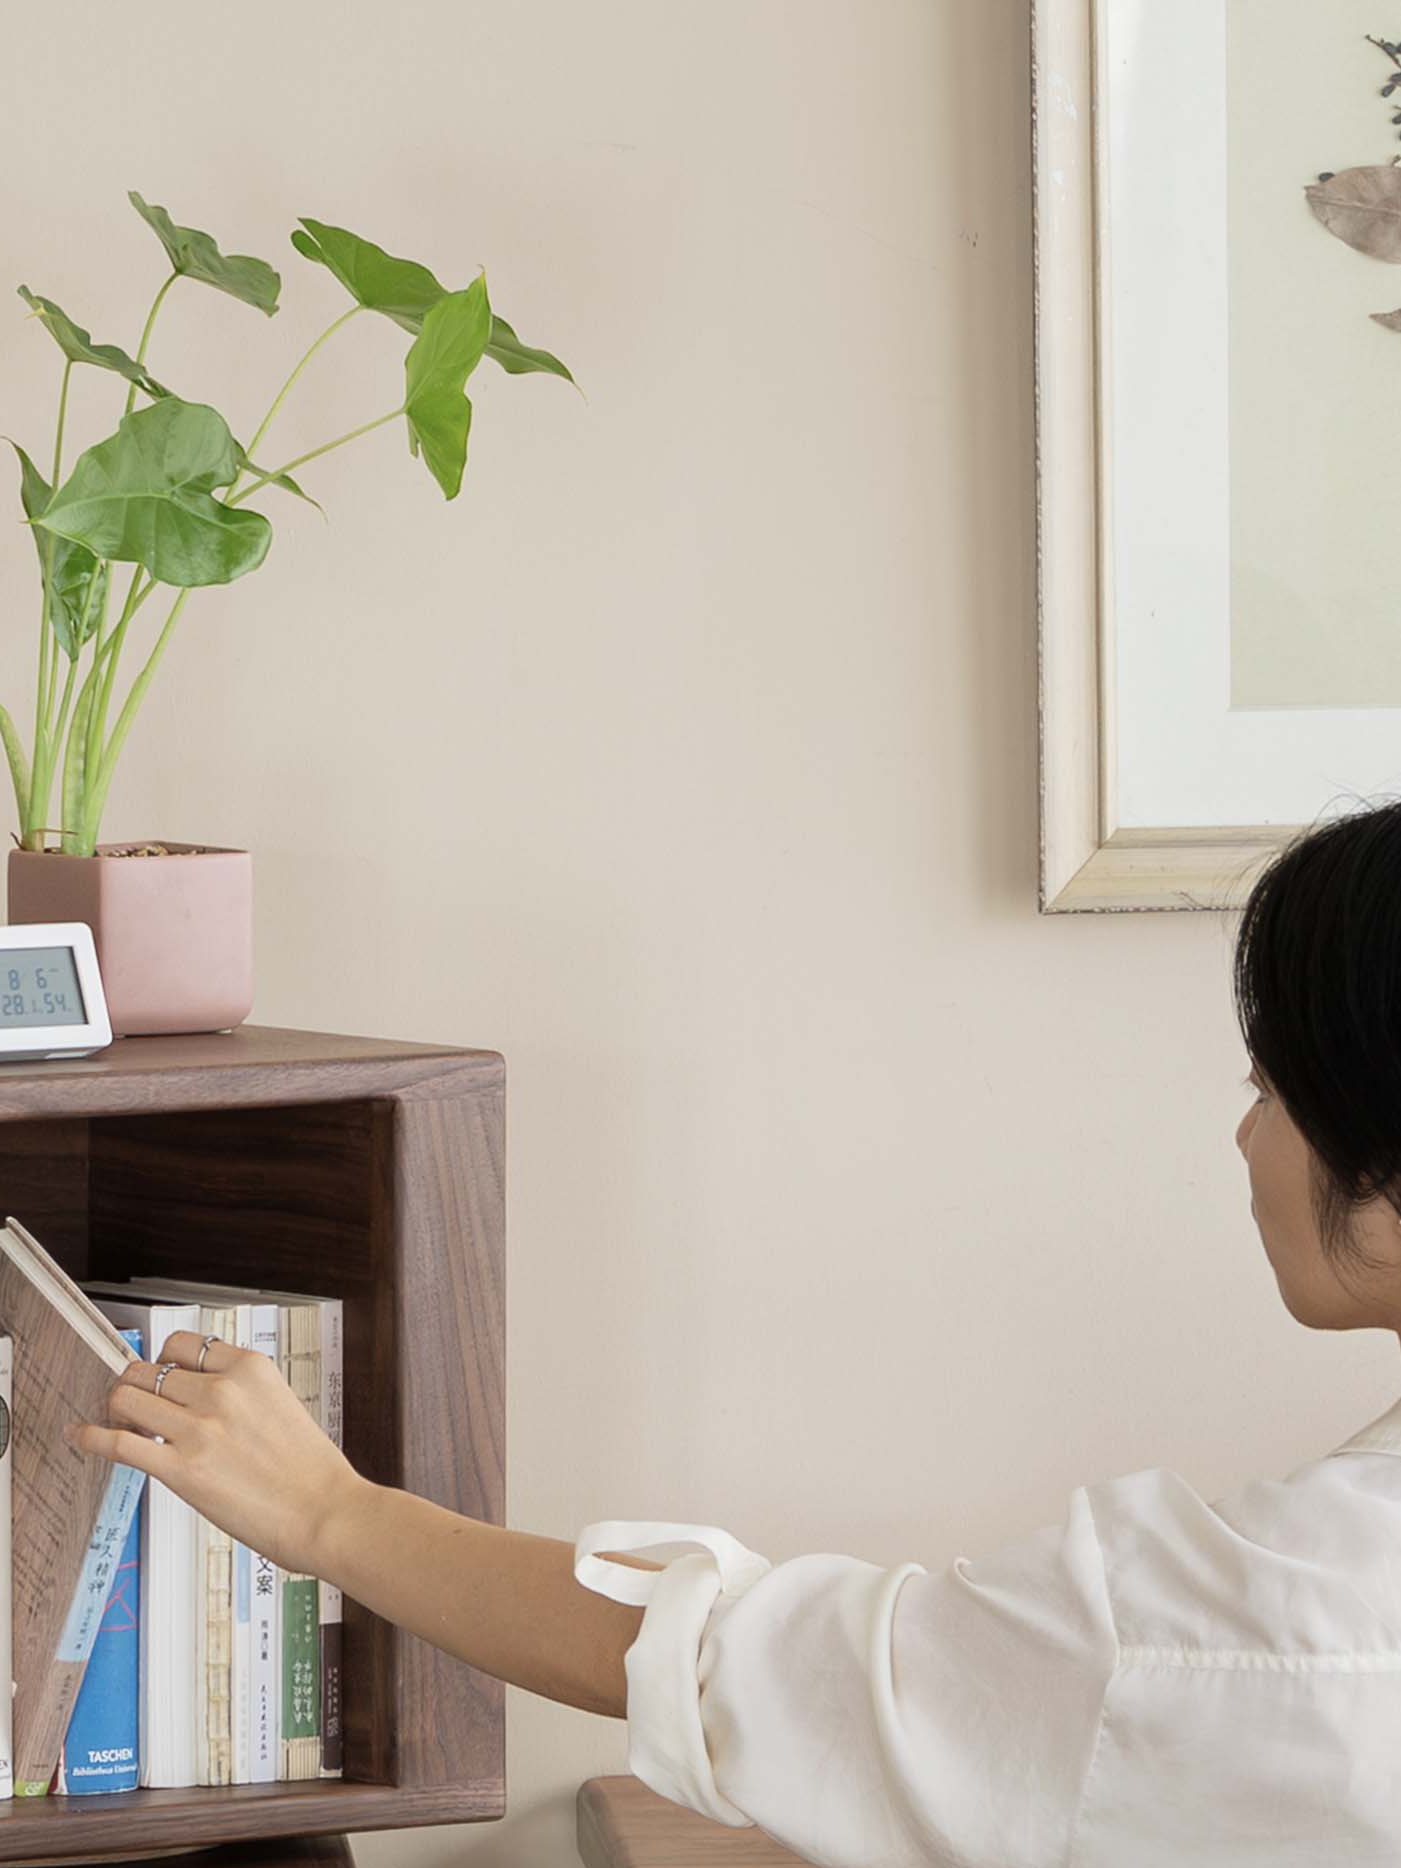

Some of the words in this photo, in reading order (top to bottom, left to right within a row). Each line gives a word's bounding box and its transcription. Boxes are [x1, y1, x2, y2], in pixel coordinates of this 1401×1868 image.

[7, 968, 20, 991] 8
[35, 967, 48, 990] 6
[88, 1748, 133, 1763] TASCHEN
